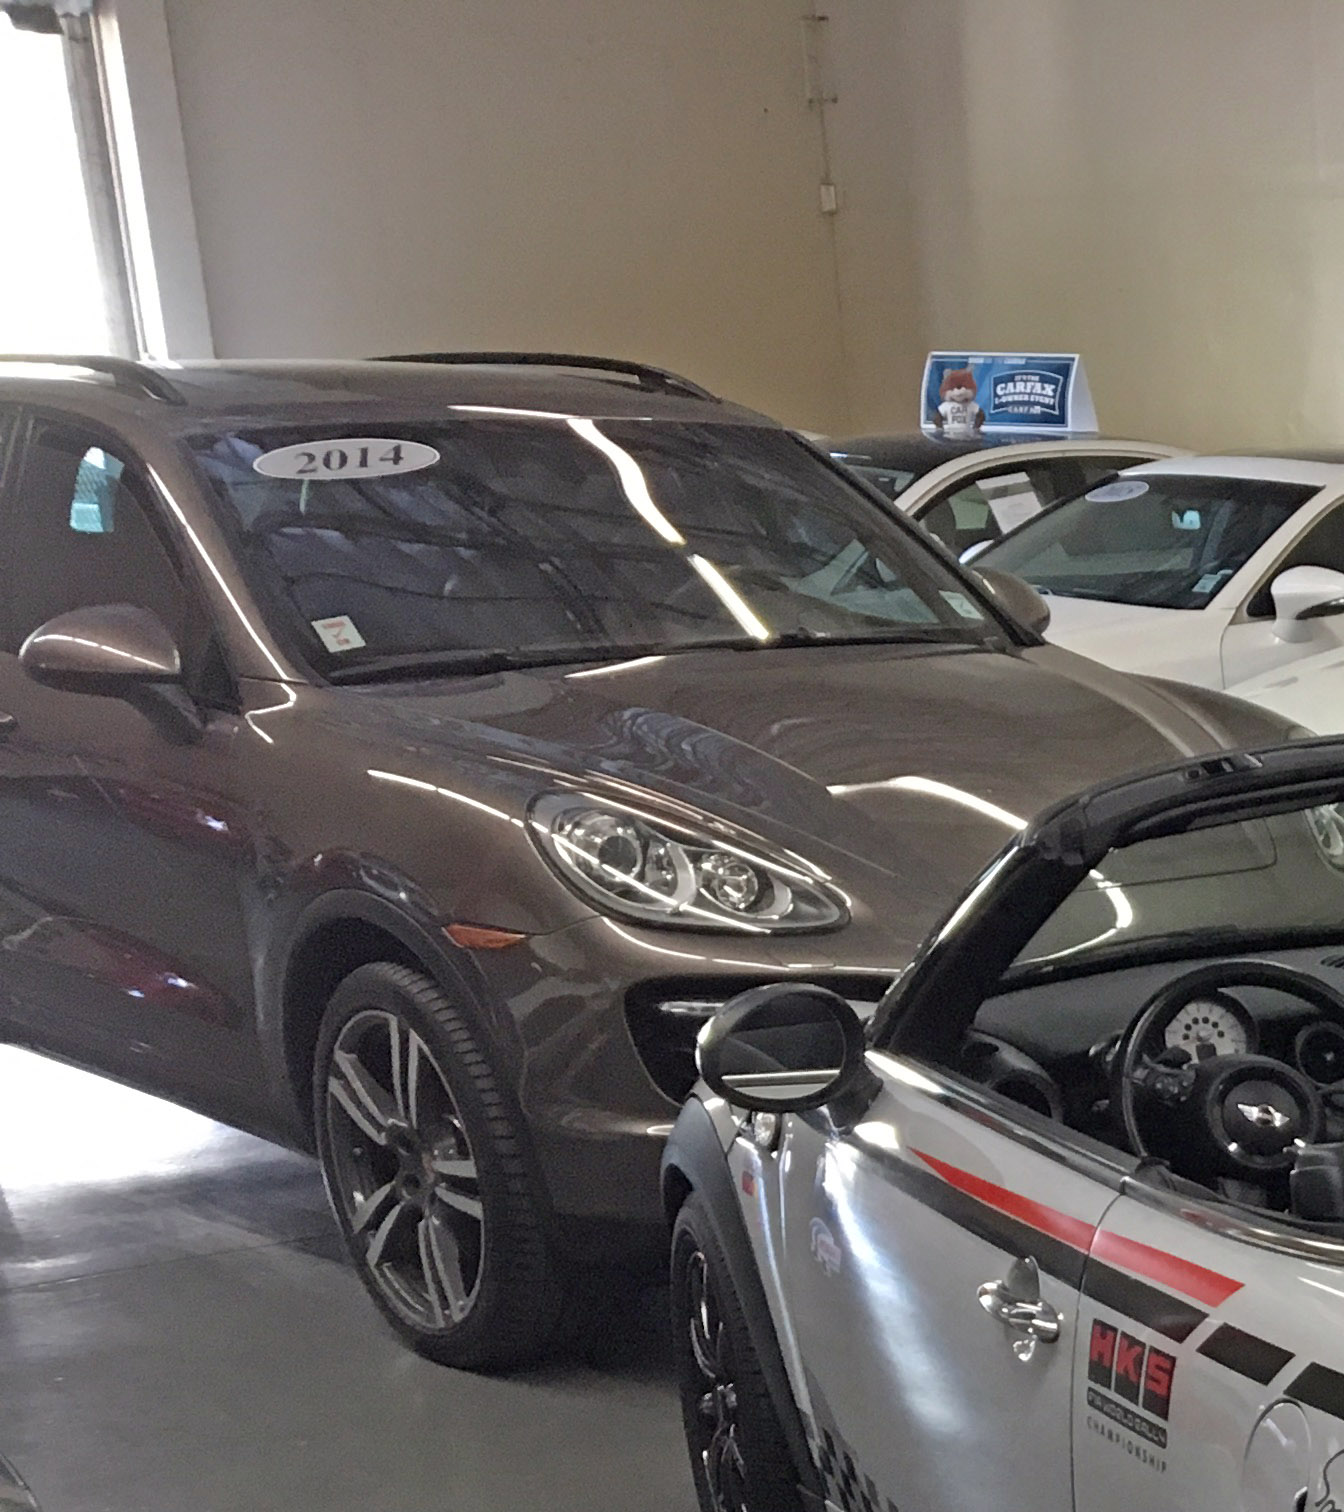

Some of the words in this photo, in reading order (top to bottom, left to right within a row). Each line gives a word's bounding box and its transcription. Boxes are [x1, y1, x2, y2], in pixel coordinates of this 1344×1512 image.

[996, 381, 1055, 396] CARFAX
[294, 443, 405, 475] 2014
[1089, 1324, 1174, 1398] HKS
